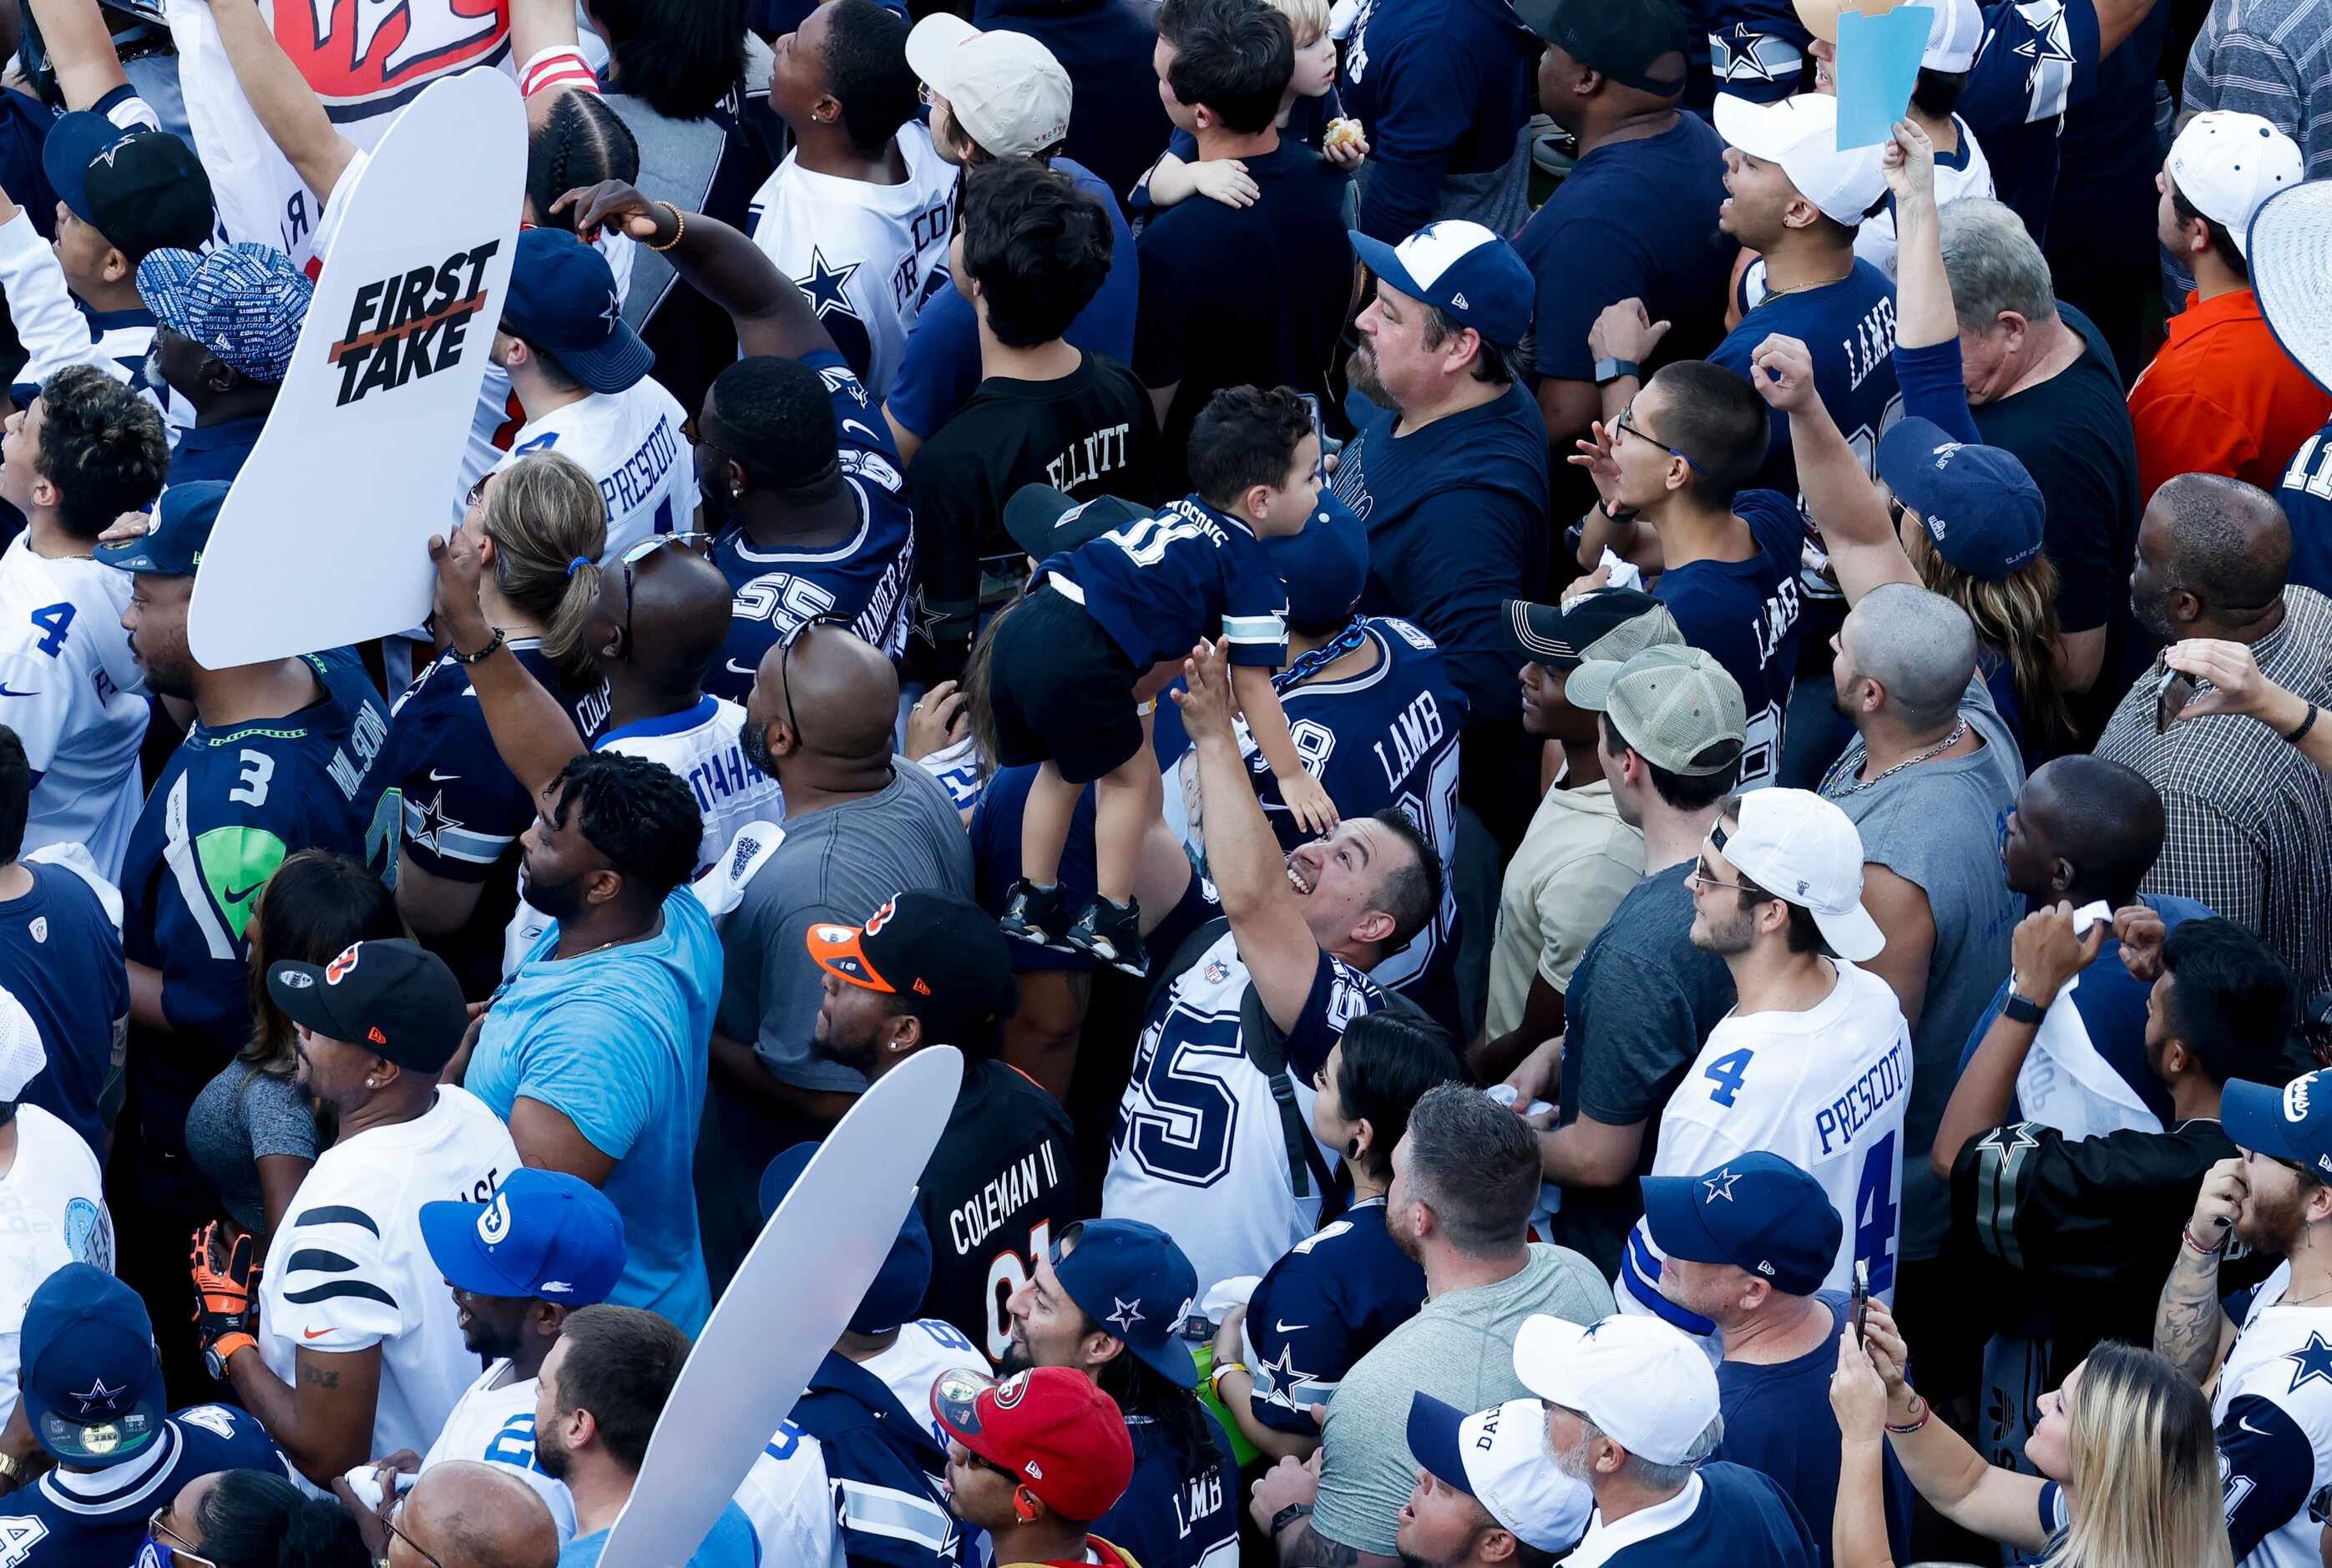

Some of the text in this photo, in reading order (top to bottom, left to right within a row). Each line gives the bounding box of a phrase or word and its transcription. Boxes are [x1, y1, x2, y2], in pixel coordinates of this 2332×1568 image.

[345, 239, 500, 346] FIRST
[336, 306, 473, 407] TAKE
[598, 412, 677, 524] PRESCOTT
[1045, 422, 1129, 494] ELLITT
[31, 601, 77, 659] 4
[850, 563, 898, 648] VANDER
[1753, 576, 1800, 670] LMB
[229, 748, 276, 807] 3
[689, 746, 768, 814] TRAHA
[1282, 712, 1337, 782] 8
[1373, 690, 1444, 794] LAMB
[1113, 1002, 1246, 1189] 5
[1704, 1047, 1755, 1110] 4
[949, 1164, 1040, 1256] COLEMAN
[1853, 1129, 1897, 1297] 4
[1171, 1477, 1223, 1540] LMB
